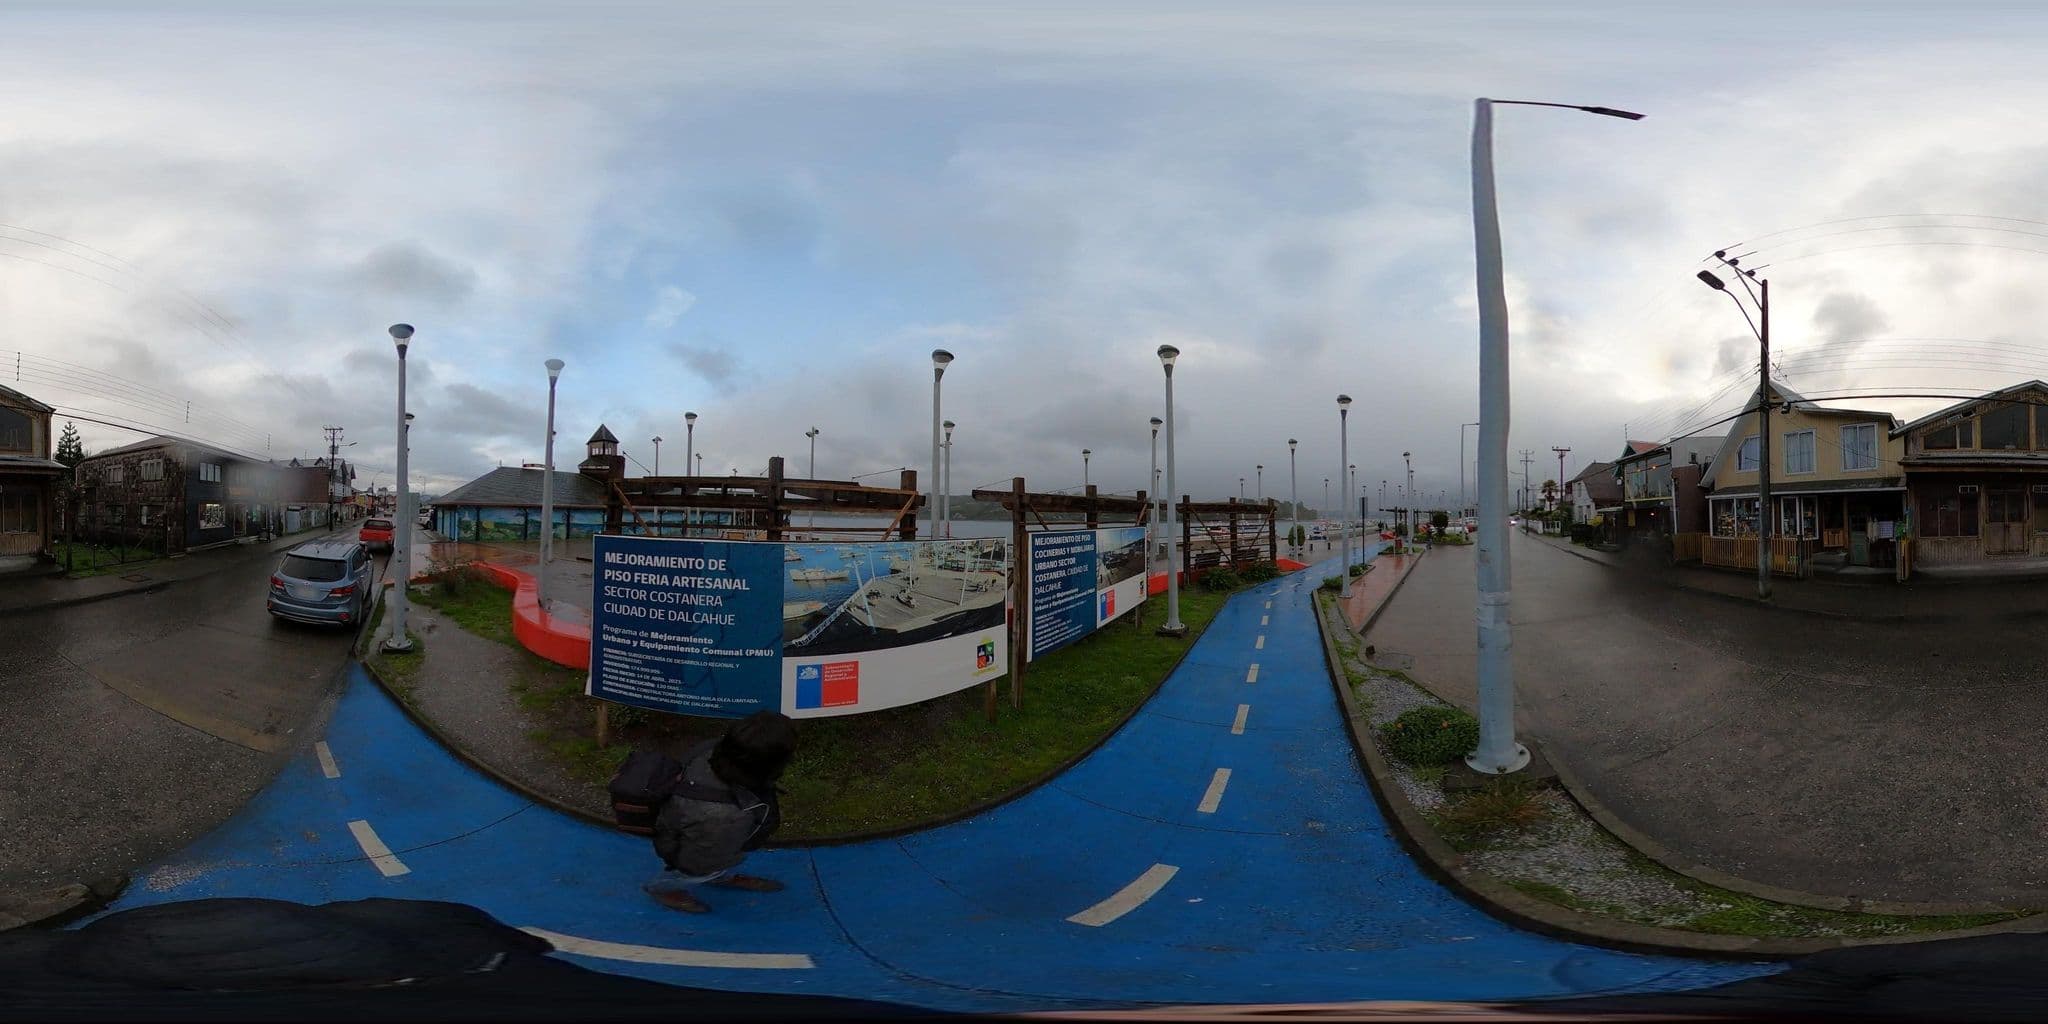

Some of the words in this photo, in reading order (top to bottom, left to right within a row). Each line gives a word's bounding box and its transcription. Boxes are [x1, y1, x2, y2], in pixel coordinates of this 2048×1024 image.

[1035, 536, 1074, 546] MEJORAMIENTO
[604, 552, 704, 570] MEJORAMIENTO
[708, 559, 726, 571] DE
[1035, 560, 1057, 571] URBANO
[1058, 557, 1076, 567] SECTOR
[604, 569, 632, 582] PISO
[634, 572, 669, 586] FERIA
[672, 575, 750, 590] ARTESANAL
[1035, 582, 1062, 595] DALCAHUE
[604, 586, 647, 600] SECTOR
[650, 590, 722, 607] COSTANERA
[604, 602, 646, 618] CIUDAD
[650, 608, 666, 620] DE
[668, 610, 736, 626] DALCAHUE
[602, 624, 638, 638] Programa
[639, 630, 649, 638] de
[650, 632, 714, 644] Mejoramiento
[602, 634, 631, 644] Urbano
[632, 639, 637, 647] y
[640, 641, 700, 654] Equipamiento
[702, 647, 743, 657] Comunal
